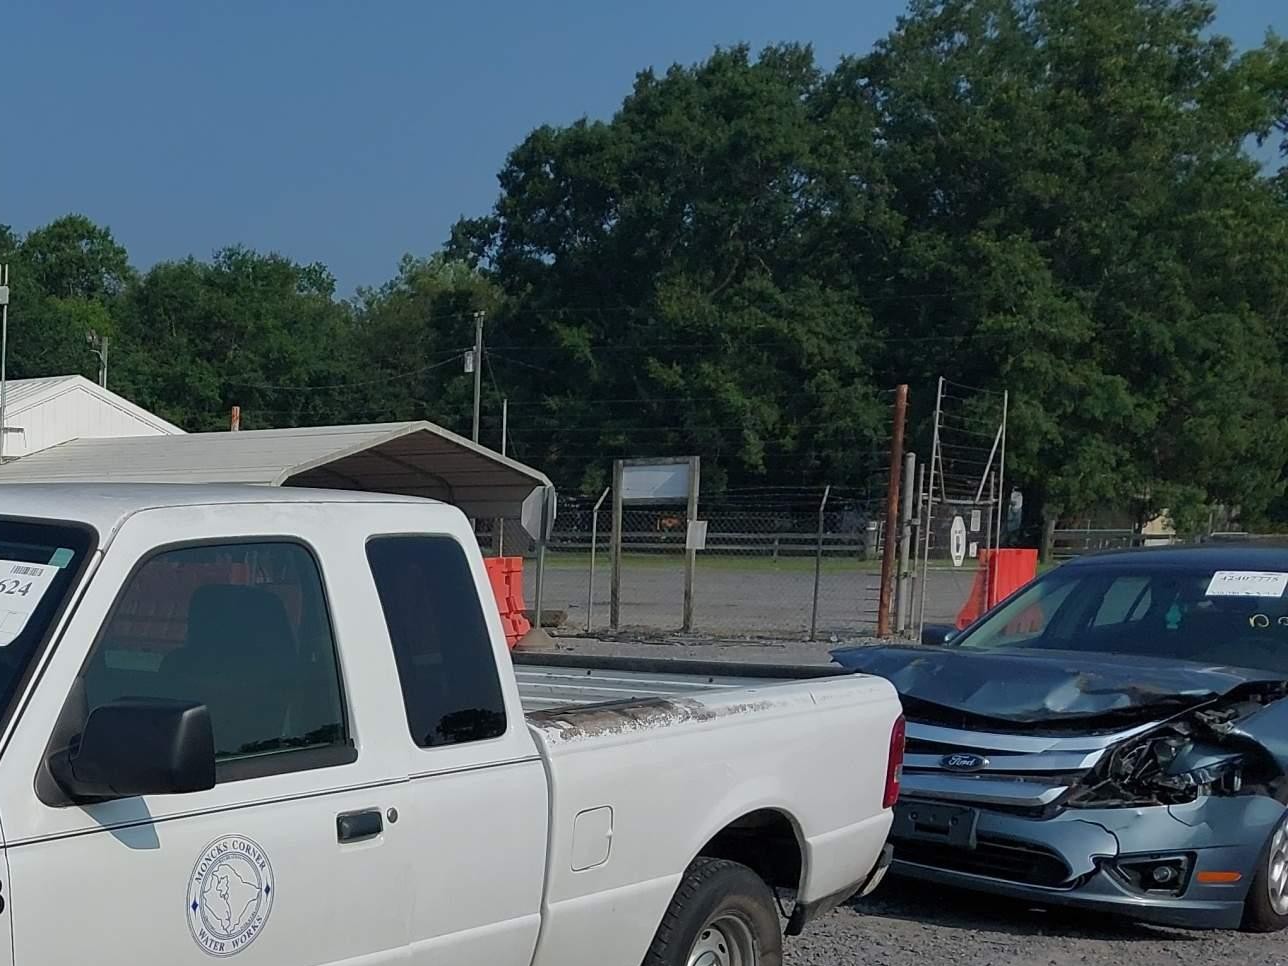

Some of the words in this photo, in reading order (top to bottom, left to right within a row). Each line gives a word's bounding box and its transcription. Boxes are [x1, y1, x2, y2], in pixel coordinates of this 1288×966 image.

[948, 755, 975, 766] Ford
[195, 841, 228, 885] MONCKS
[232, 840, 266, 871] CORNER
[198, 928, 225, 952] WATER
[231, 915, 263, 949] WORKS
